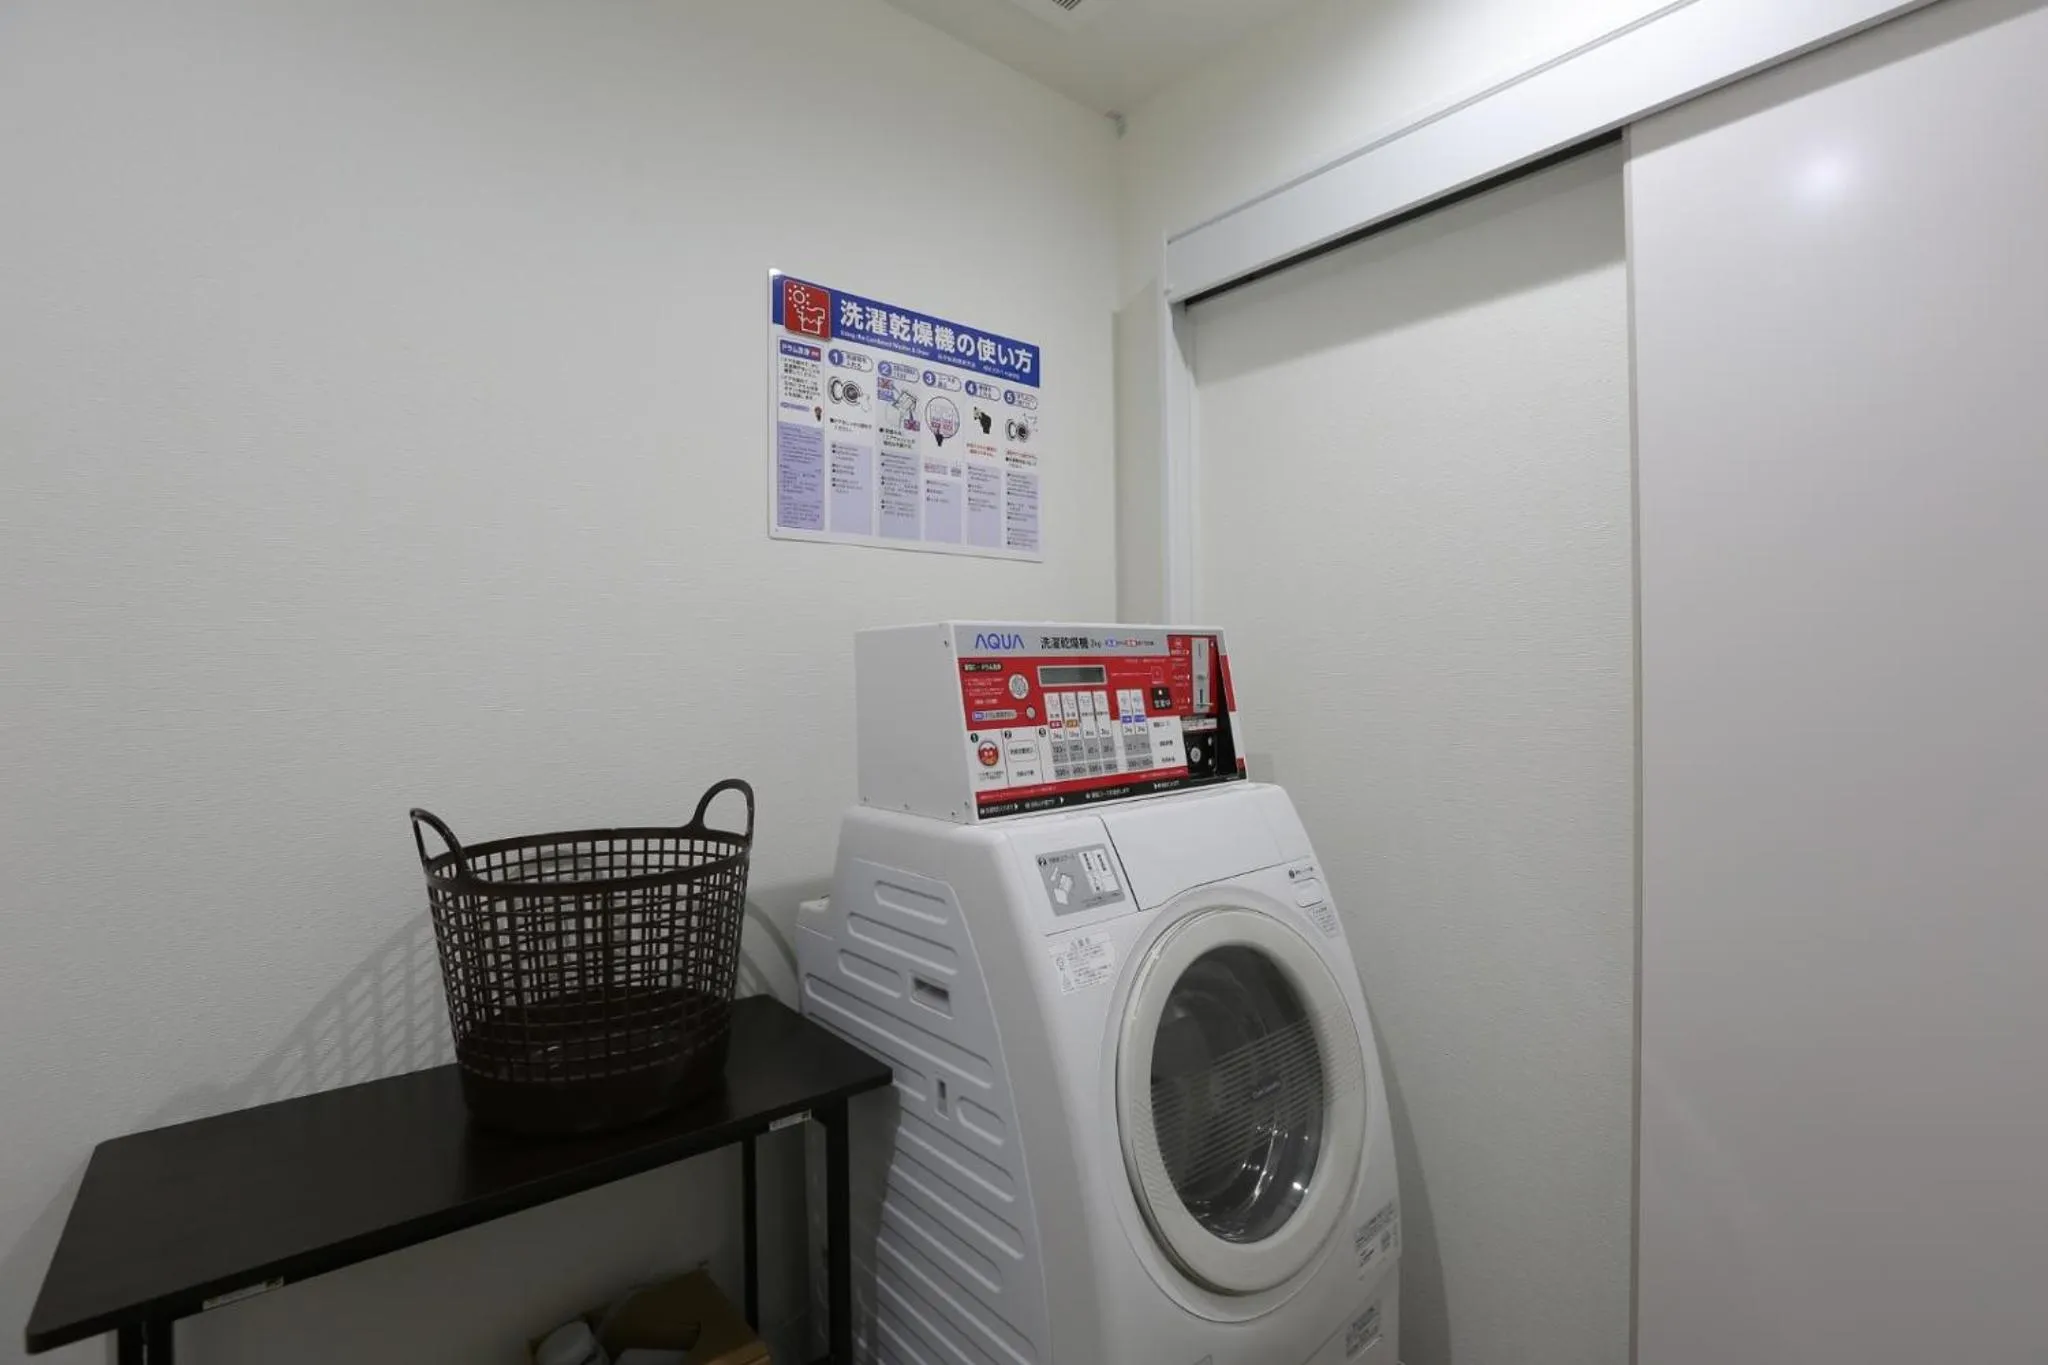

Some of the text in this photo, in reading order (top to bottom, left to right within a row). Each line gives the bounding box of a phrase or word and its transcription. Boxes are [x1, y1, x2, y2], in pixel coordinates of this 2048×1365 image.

[840, 299, 1033, 373] 洗濯乾燥機の使い方
[975, 633, 1025, 650] AQUA
[1040, 636, 1089, 650] 洗濯乾燥機
